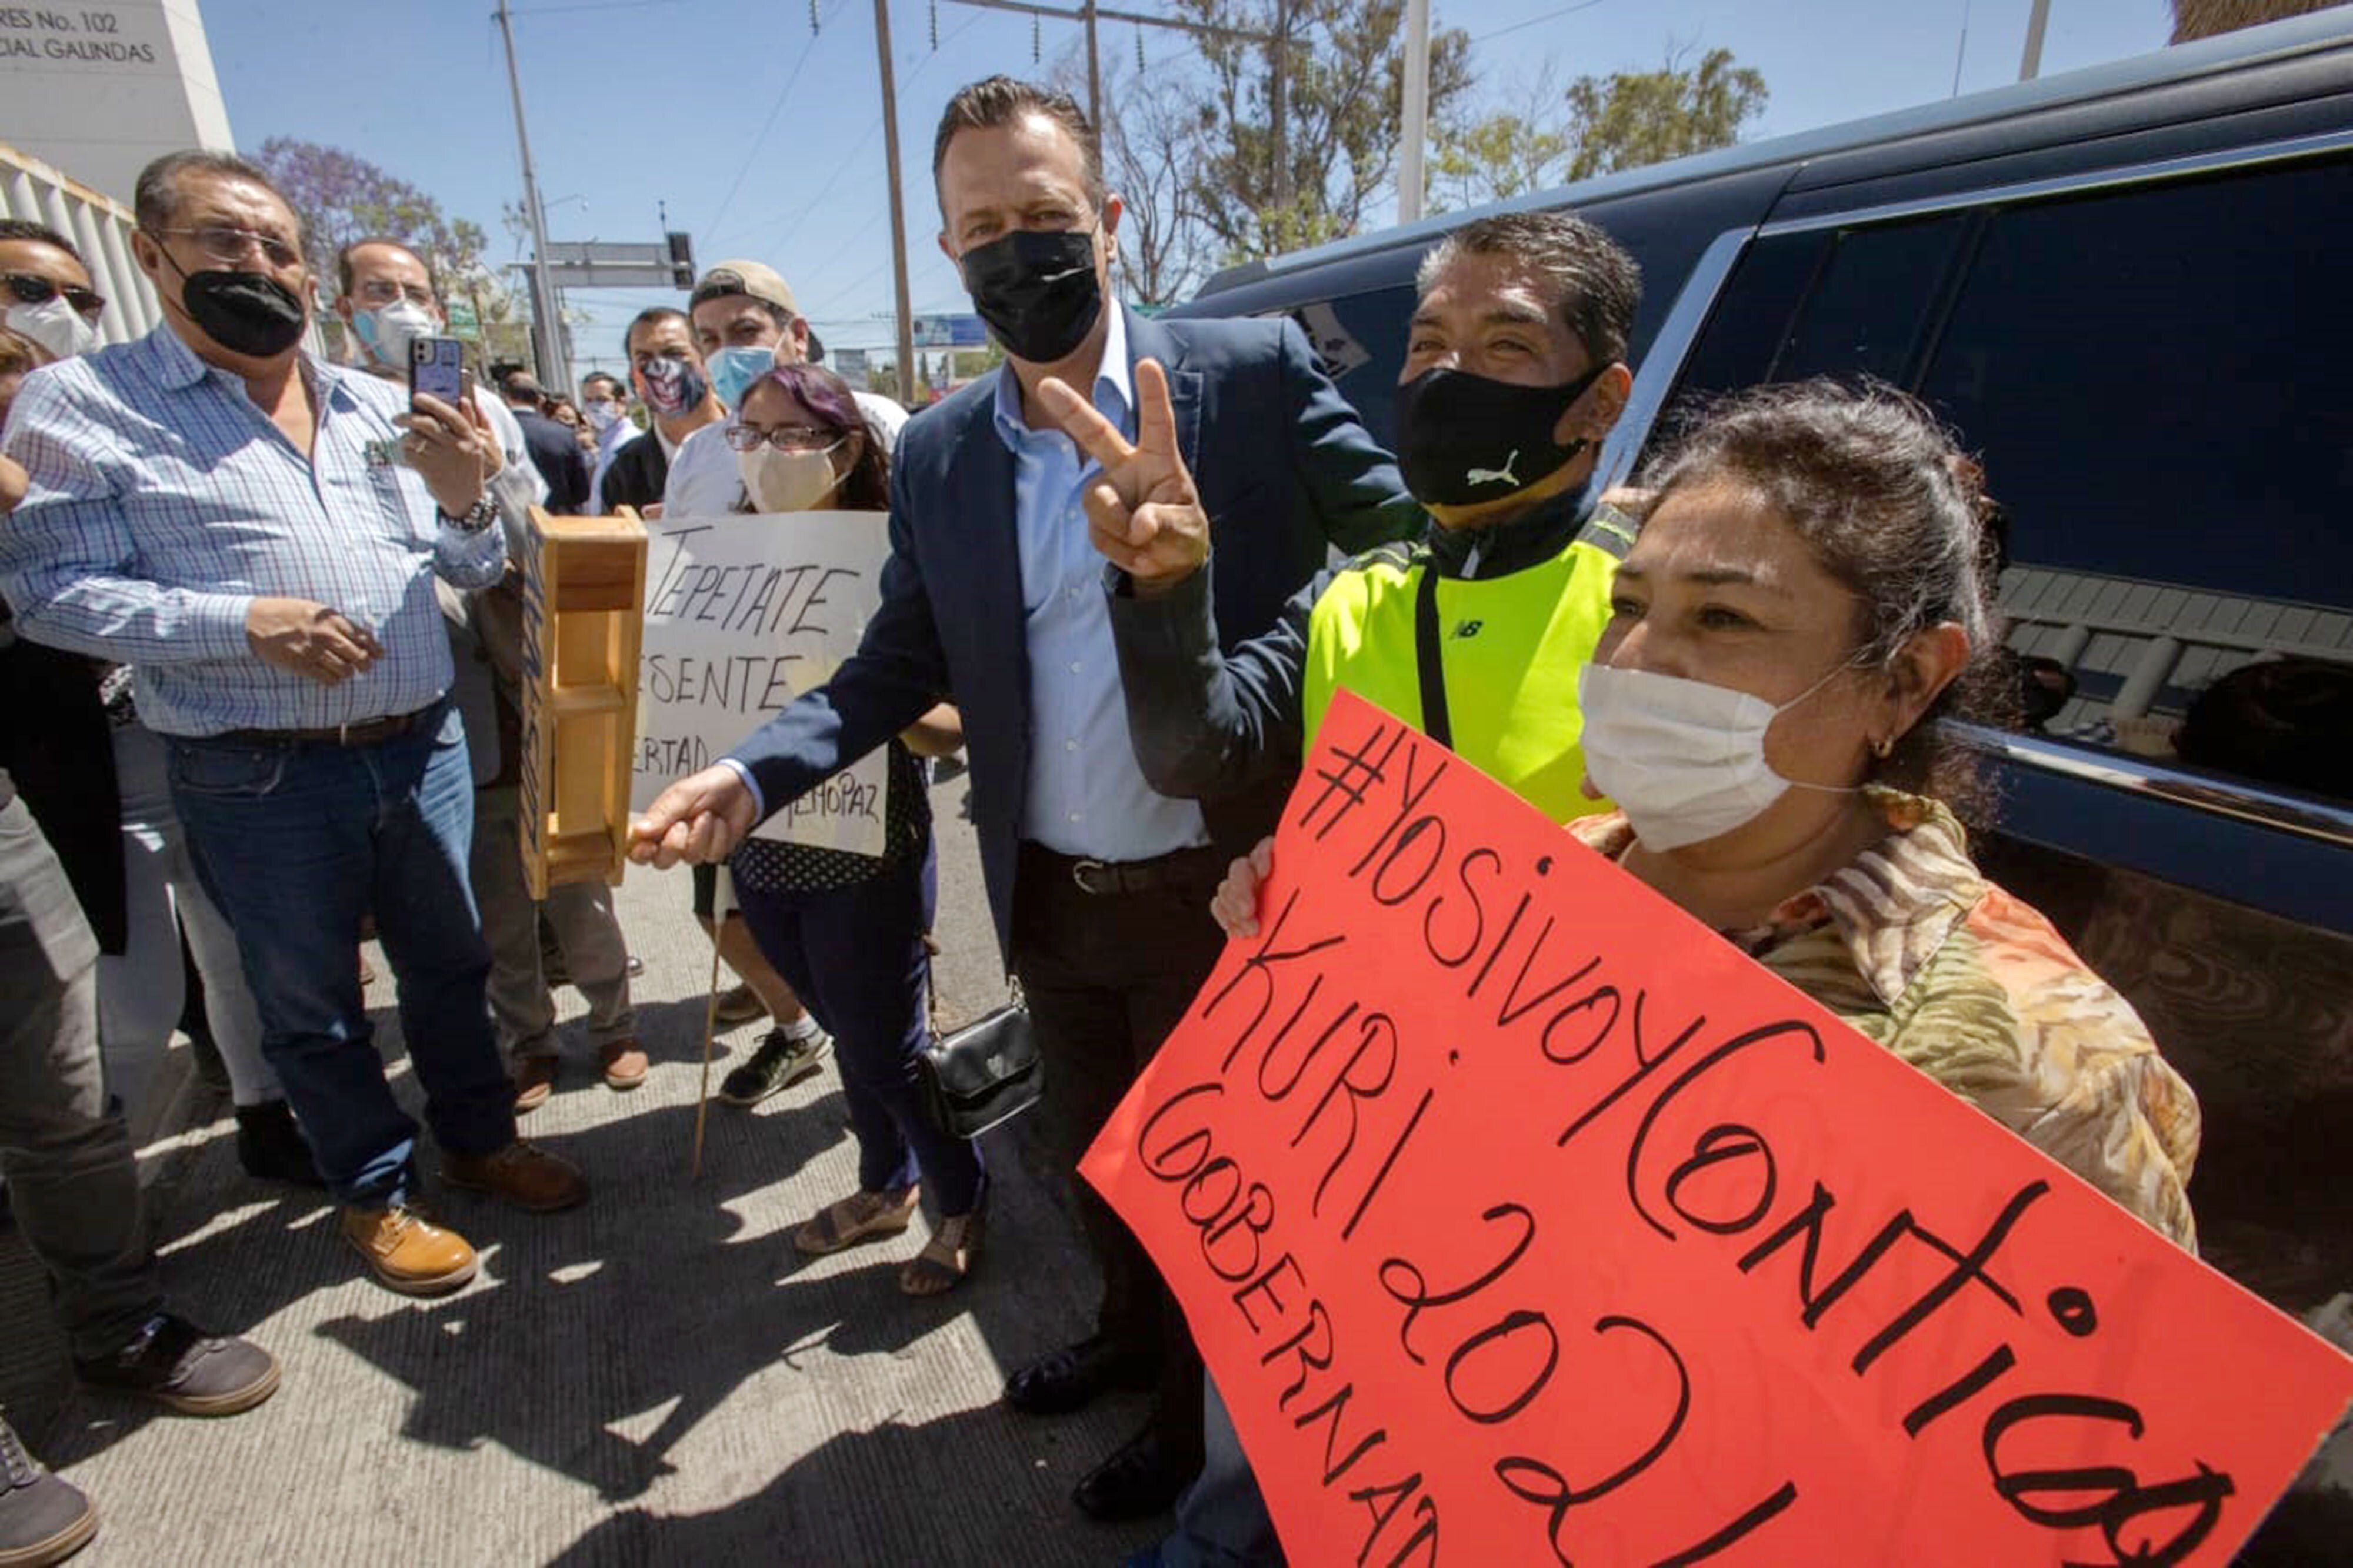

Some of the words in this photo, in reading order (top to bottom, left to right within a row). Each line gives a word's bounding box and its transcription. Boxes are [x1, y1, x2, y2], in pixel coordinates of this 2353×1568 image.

[36, 11, 75, 31] No.
[81, 12, 118, 34] 102
[44, 39, 155, 63] GALINDAS
[647, 525, 861, 637] TEPETATE
[638, 653, 804, 713] SENTE
